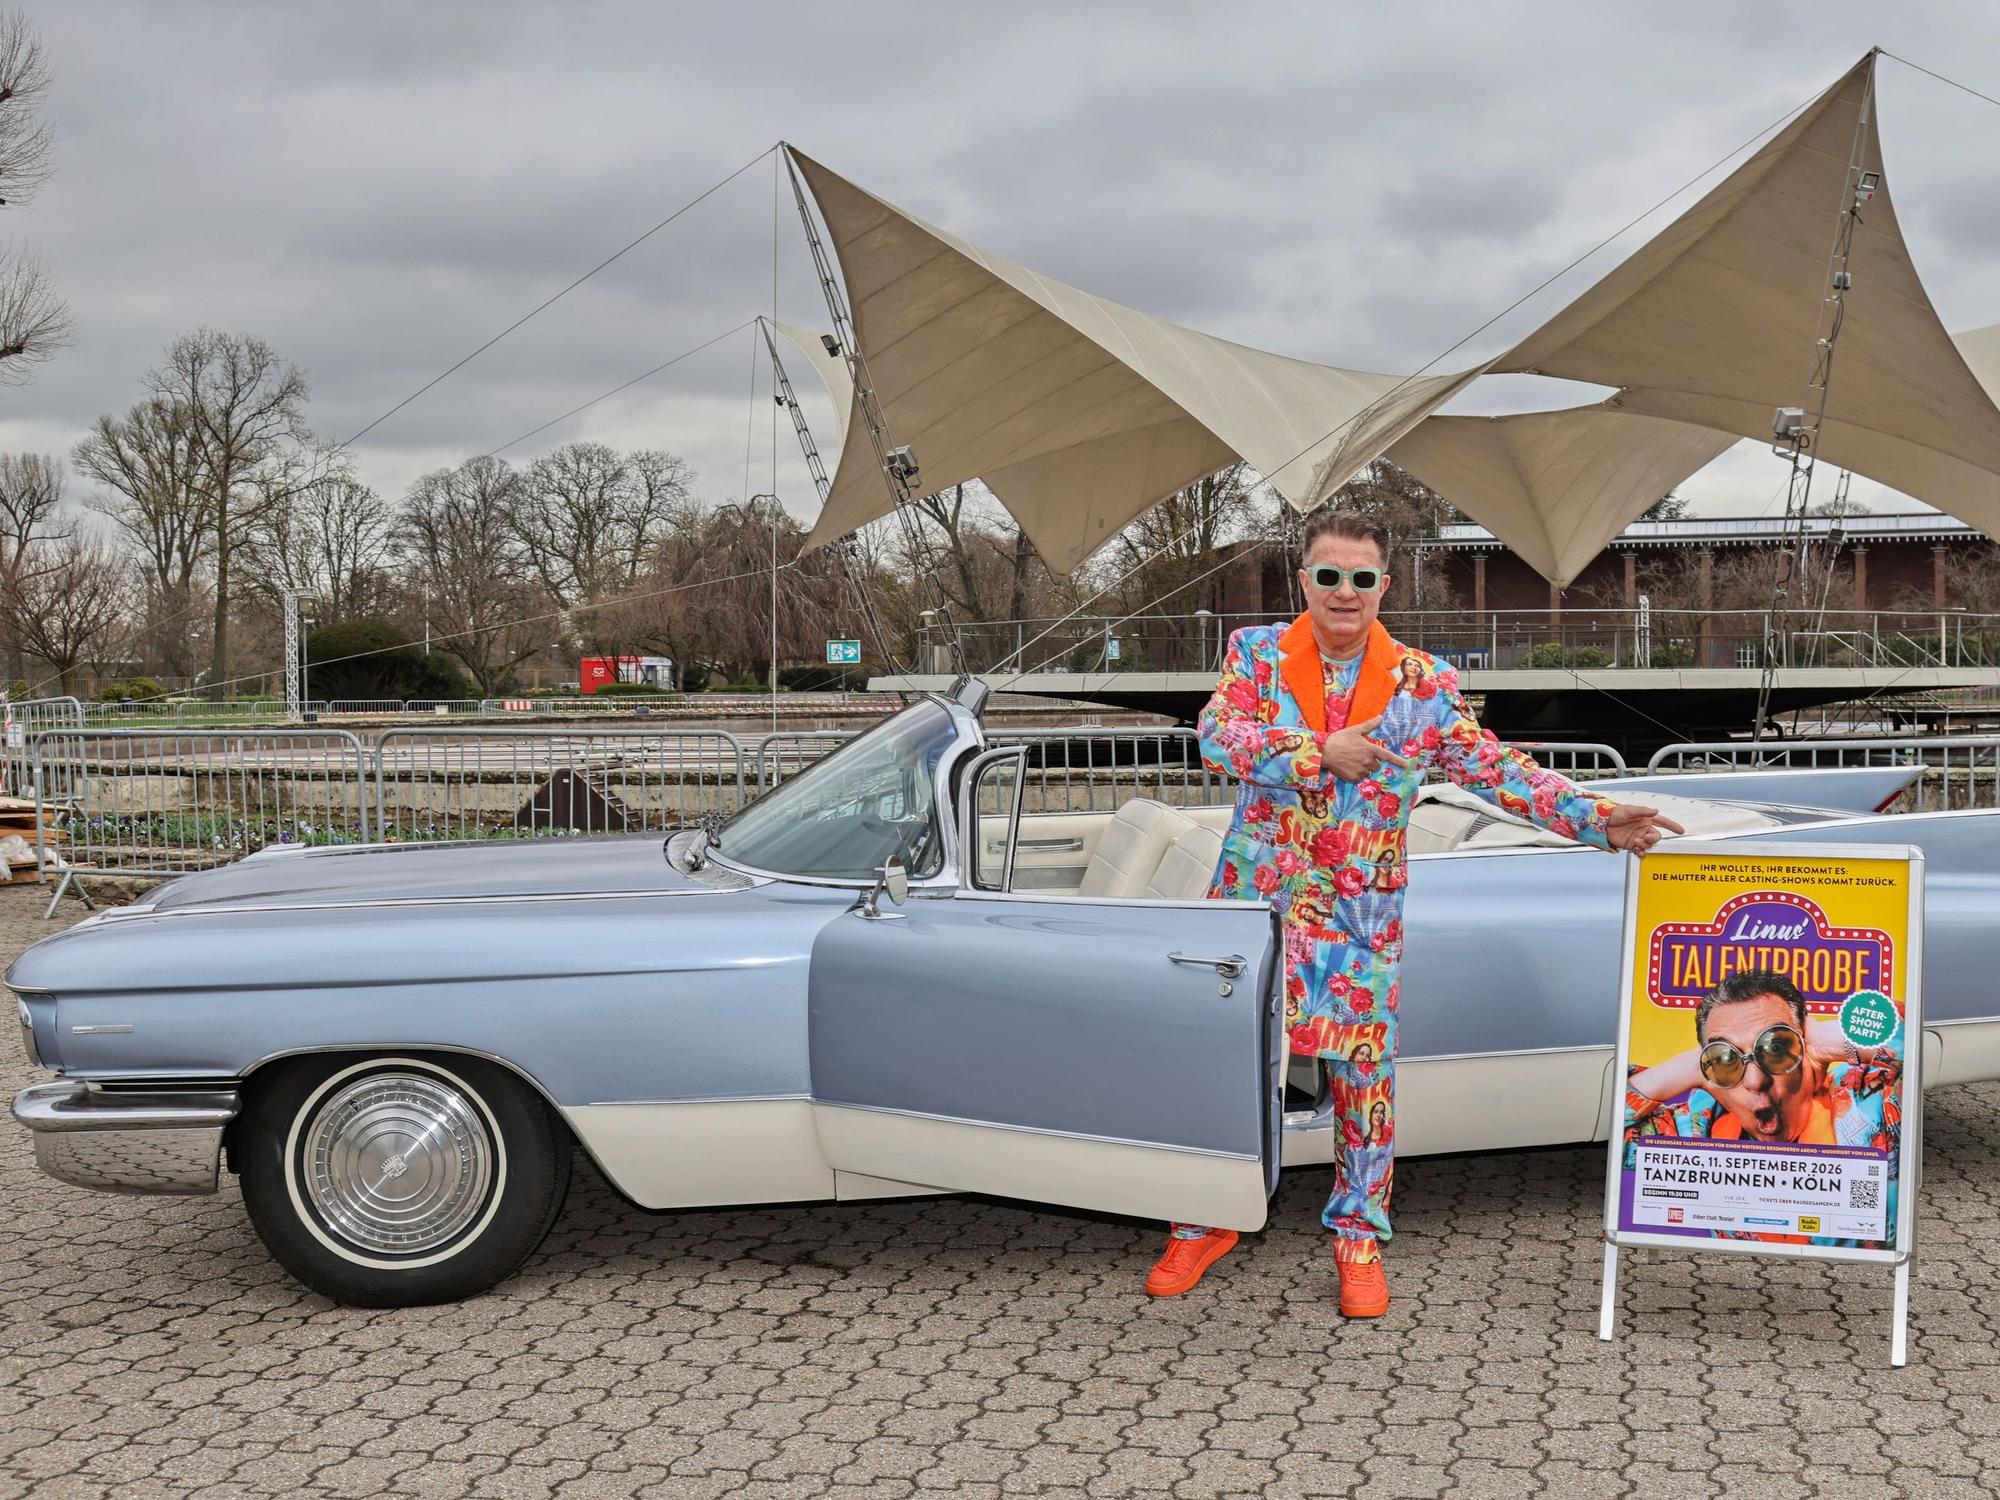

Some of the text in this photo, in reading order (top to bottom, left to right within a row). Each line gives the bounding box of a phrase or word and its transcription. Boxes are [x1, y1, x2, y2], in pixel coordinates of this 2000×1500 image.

[1700, 864, 1849, 875] IHR WOLLT ES, IHR BEKOMMT ES:
[1652, 873, 1898, 887] DIE MUTTER ALLER CASTING-SHOWS KOMMT ZURÜCK.
[1729, 913, 1810, 942] Linus'
[1851, 1006, 1888, 1021] AFTER-
[1849, 1015, 1886, 1030] SHOW-
[1848, 1024, 1882, 1040] PARTY
[1682, 1140, 1715, 1148] TALENTSHOW
[1643, 1152, 1843, 1175] FREITAG, 11. SEPTEMBER 2026
[1643, 1167, 1842, 1192] TANZBRUNNEN KÖLN
[1643, 1189, 1668, 1197] BEGINN
[1683, 1191, 1698, 1199] UHR
[1779, 1197, 1792, 1205] ÜBER
